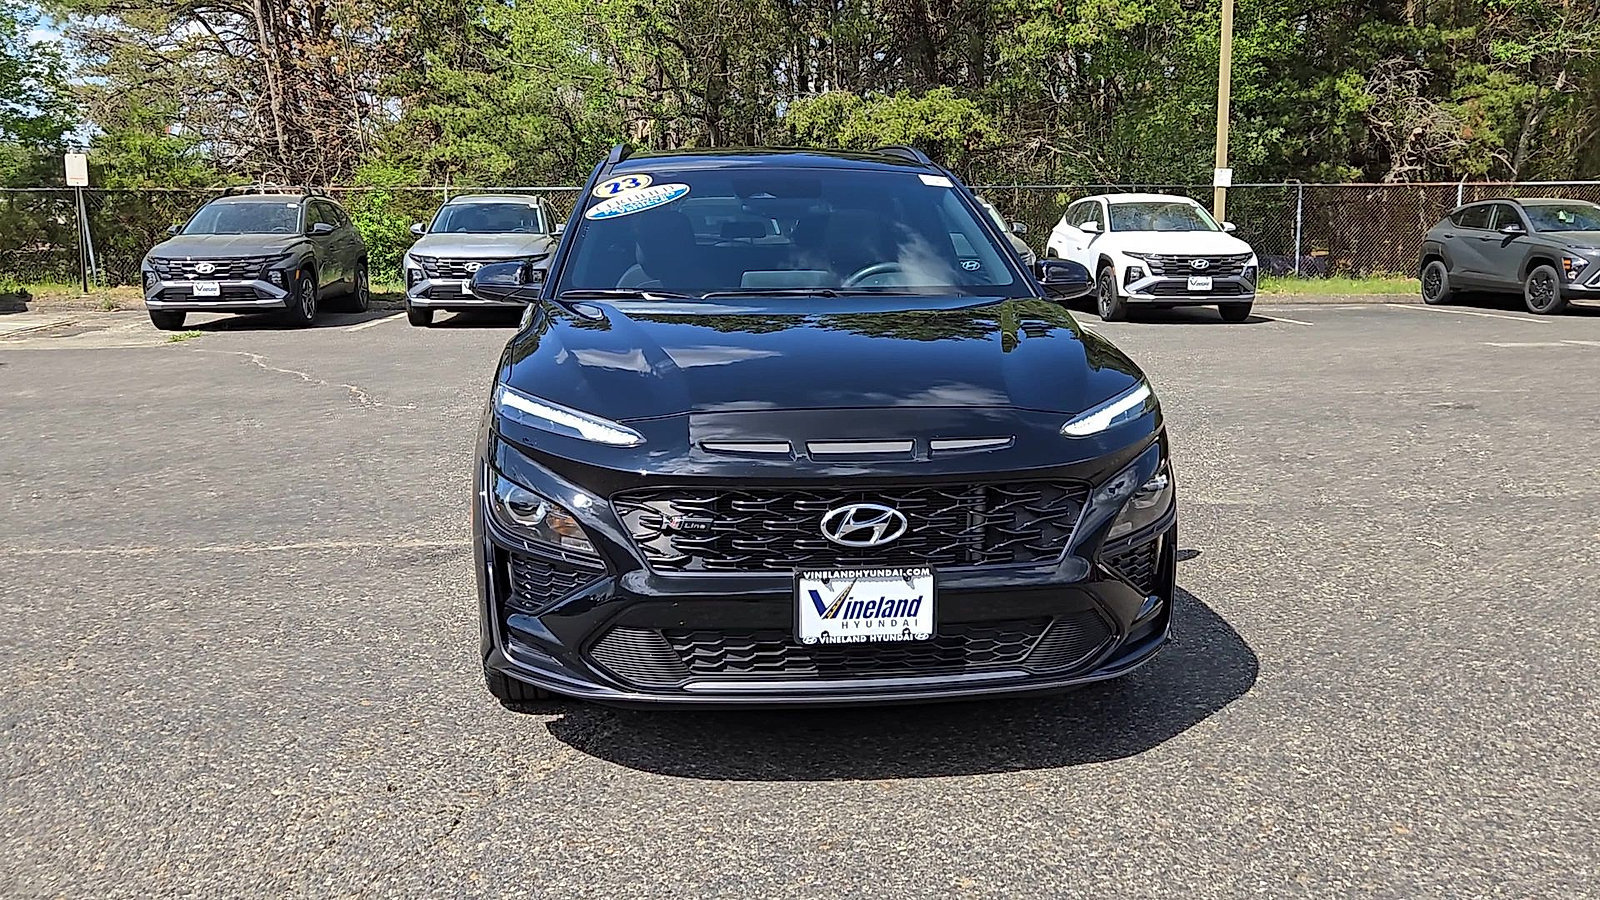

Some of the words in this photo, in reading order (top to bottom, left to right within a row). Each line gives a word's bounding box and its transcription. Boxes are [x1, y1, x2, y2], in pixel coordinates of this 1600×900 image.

[604, 177, 641, 194] 23
[803, 568, 930, 579] VINELANDHYUNDAI.COM
[808, 579, 923, 619] Vineland
[841, 619, 918, 629] HYUNDAI
[820, 635, 867, 644] VINELAND
[870, 634, 913, 642] HYUNDAI
